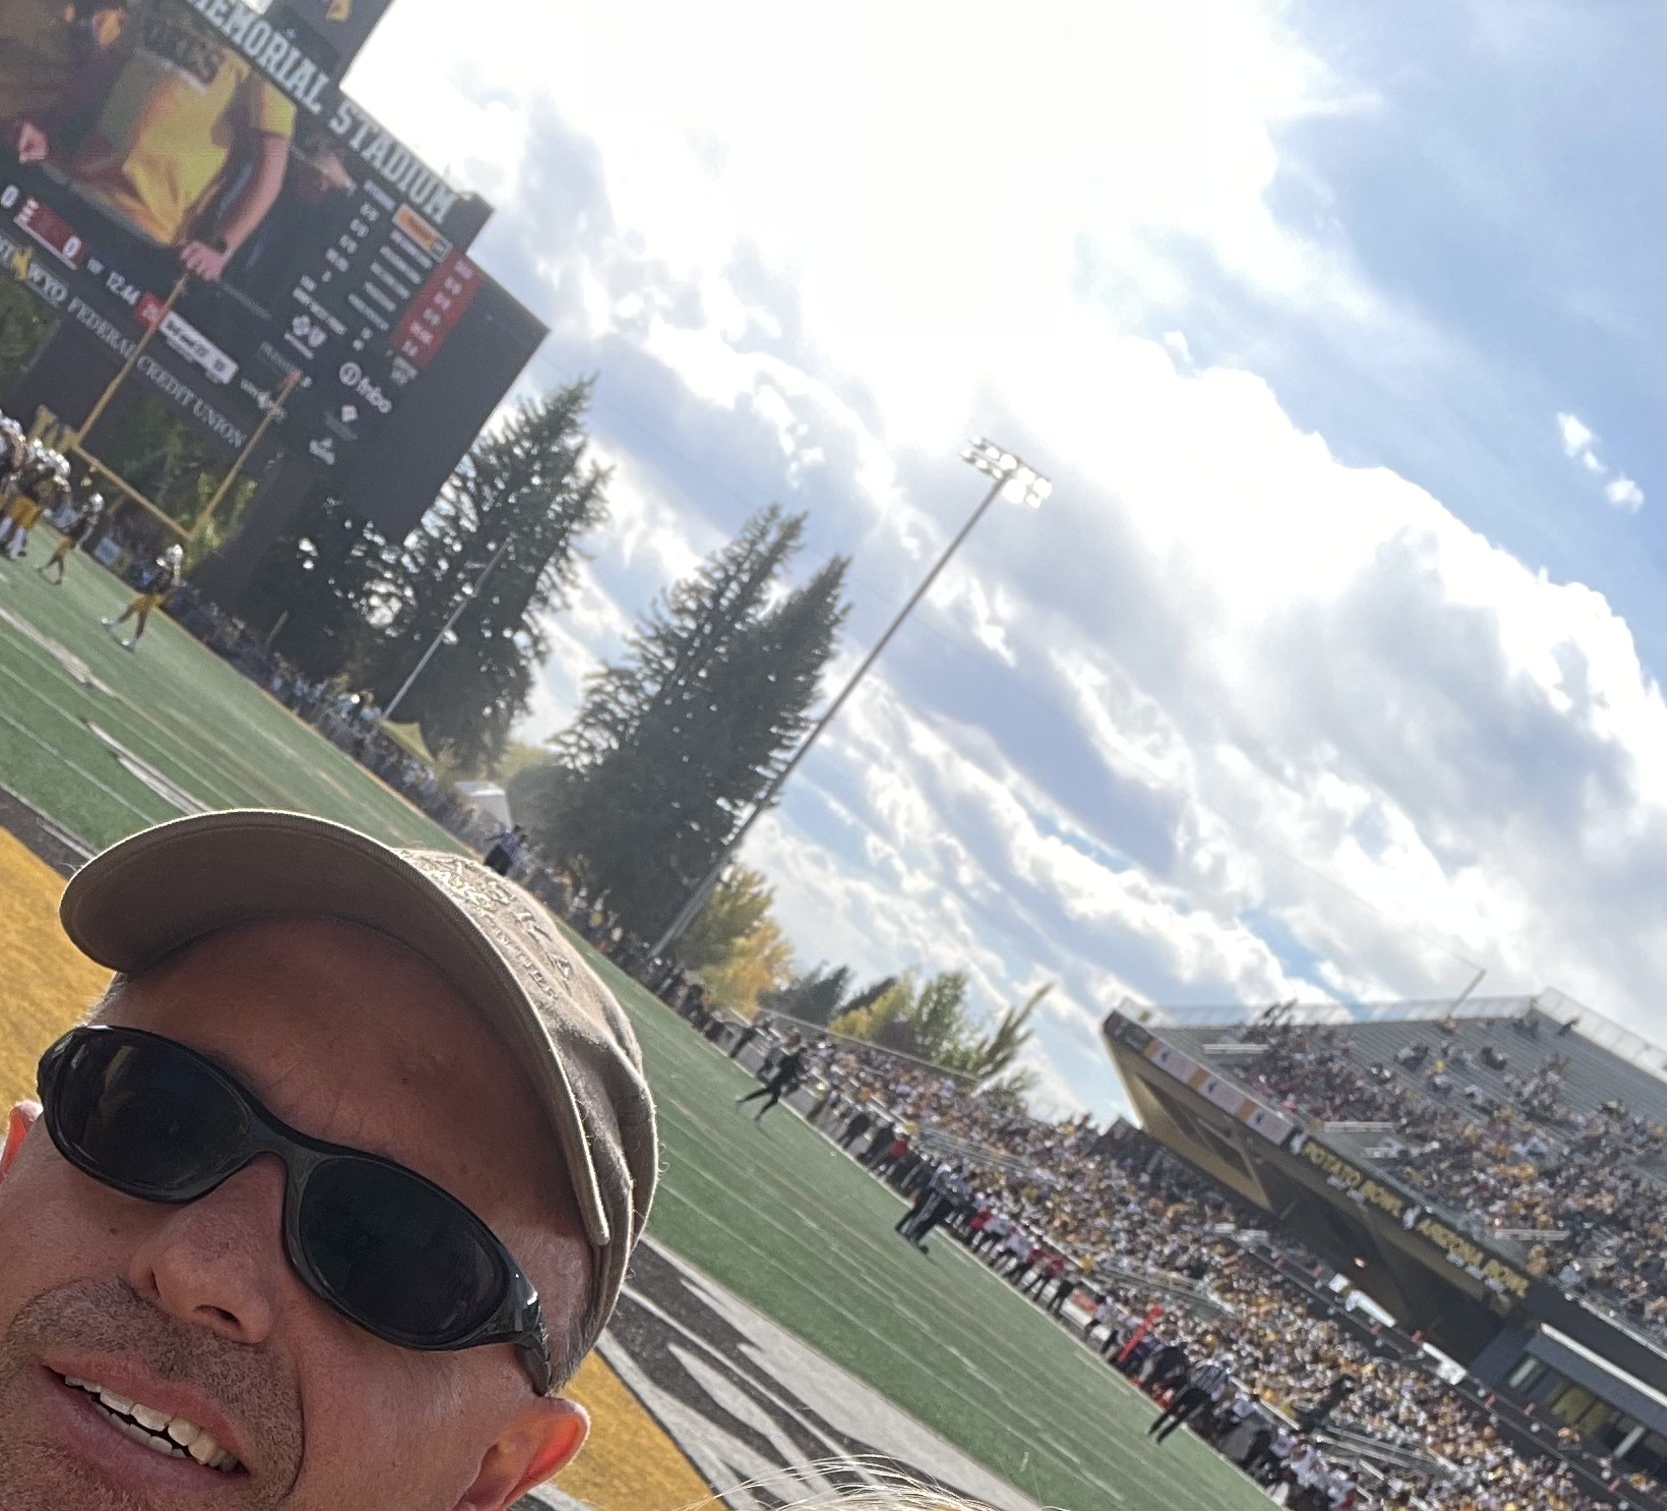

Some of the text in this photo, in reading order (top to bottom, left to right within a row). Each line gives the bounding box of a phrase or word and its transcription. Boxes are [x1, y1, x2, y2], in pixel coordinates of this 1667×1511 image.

[191, 0, 329, 115] EMORIAL
[329, 101, 460, 225] STADIUM
[26, 262, 68, 303] WYO
[67, 297, 137, 361] FEDERA
[137, 356, 197, 406] CREDIT
[193, 399, 248, 448] UNION
